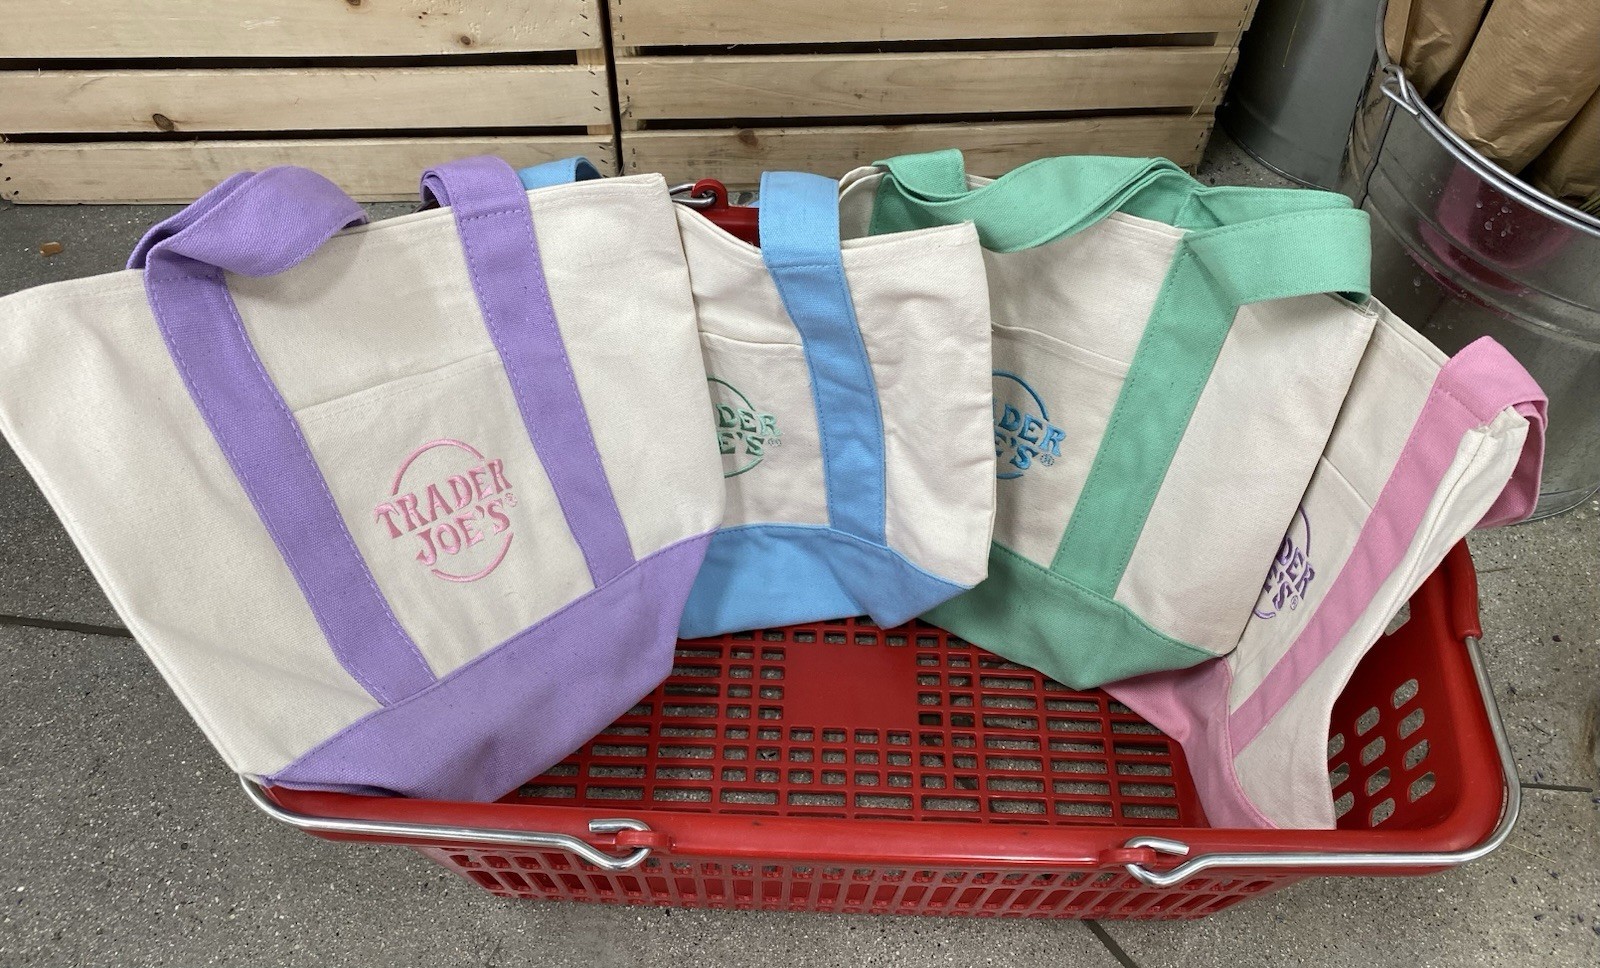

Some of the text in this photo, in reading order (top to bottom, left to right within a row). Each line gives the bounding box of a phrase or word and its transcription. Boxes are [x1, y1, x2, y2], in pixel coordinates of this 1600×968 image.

[716, 403, 782, 437] DER
[717, 431, 764, 456] E'S
[998, 403, 1066, 457] DER
[374, 458, 513, 539] TRADER
[1275, 537, 1316, 600] DER
